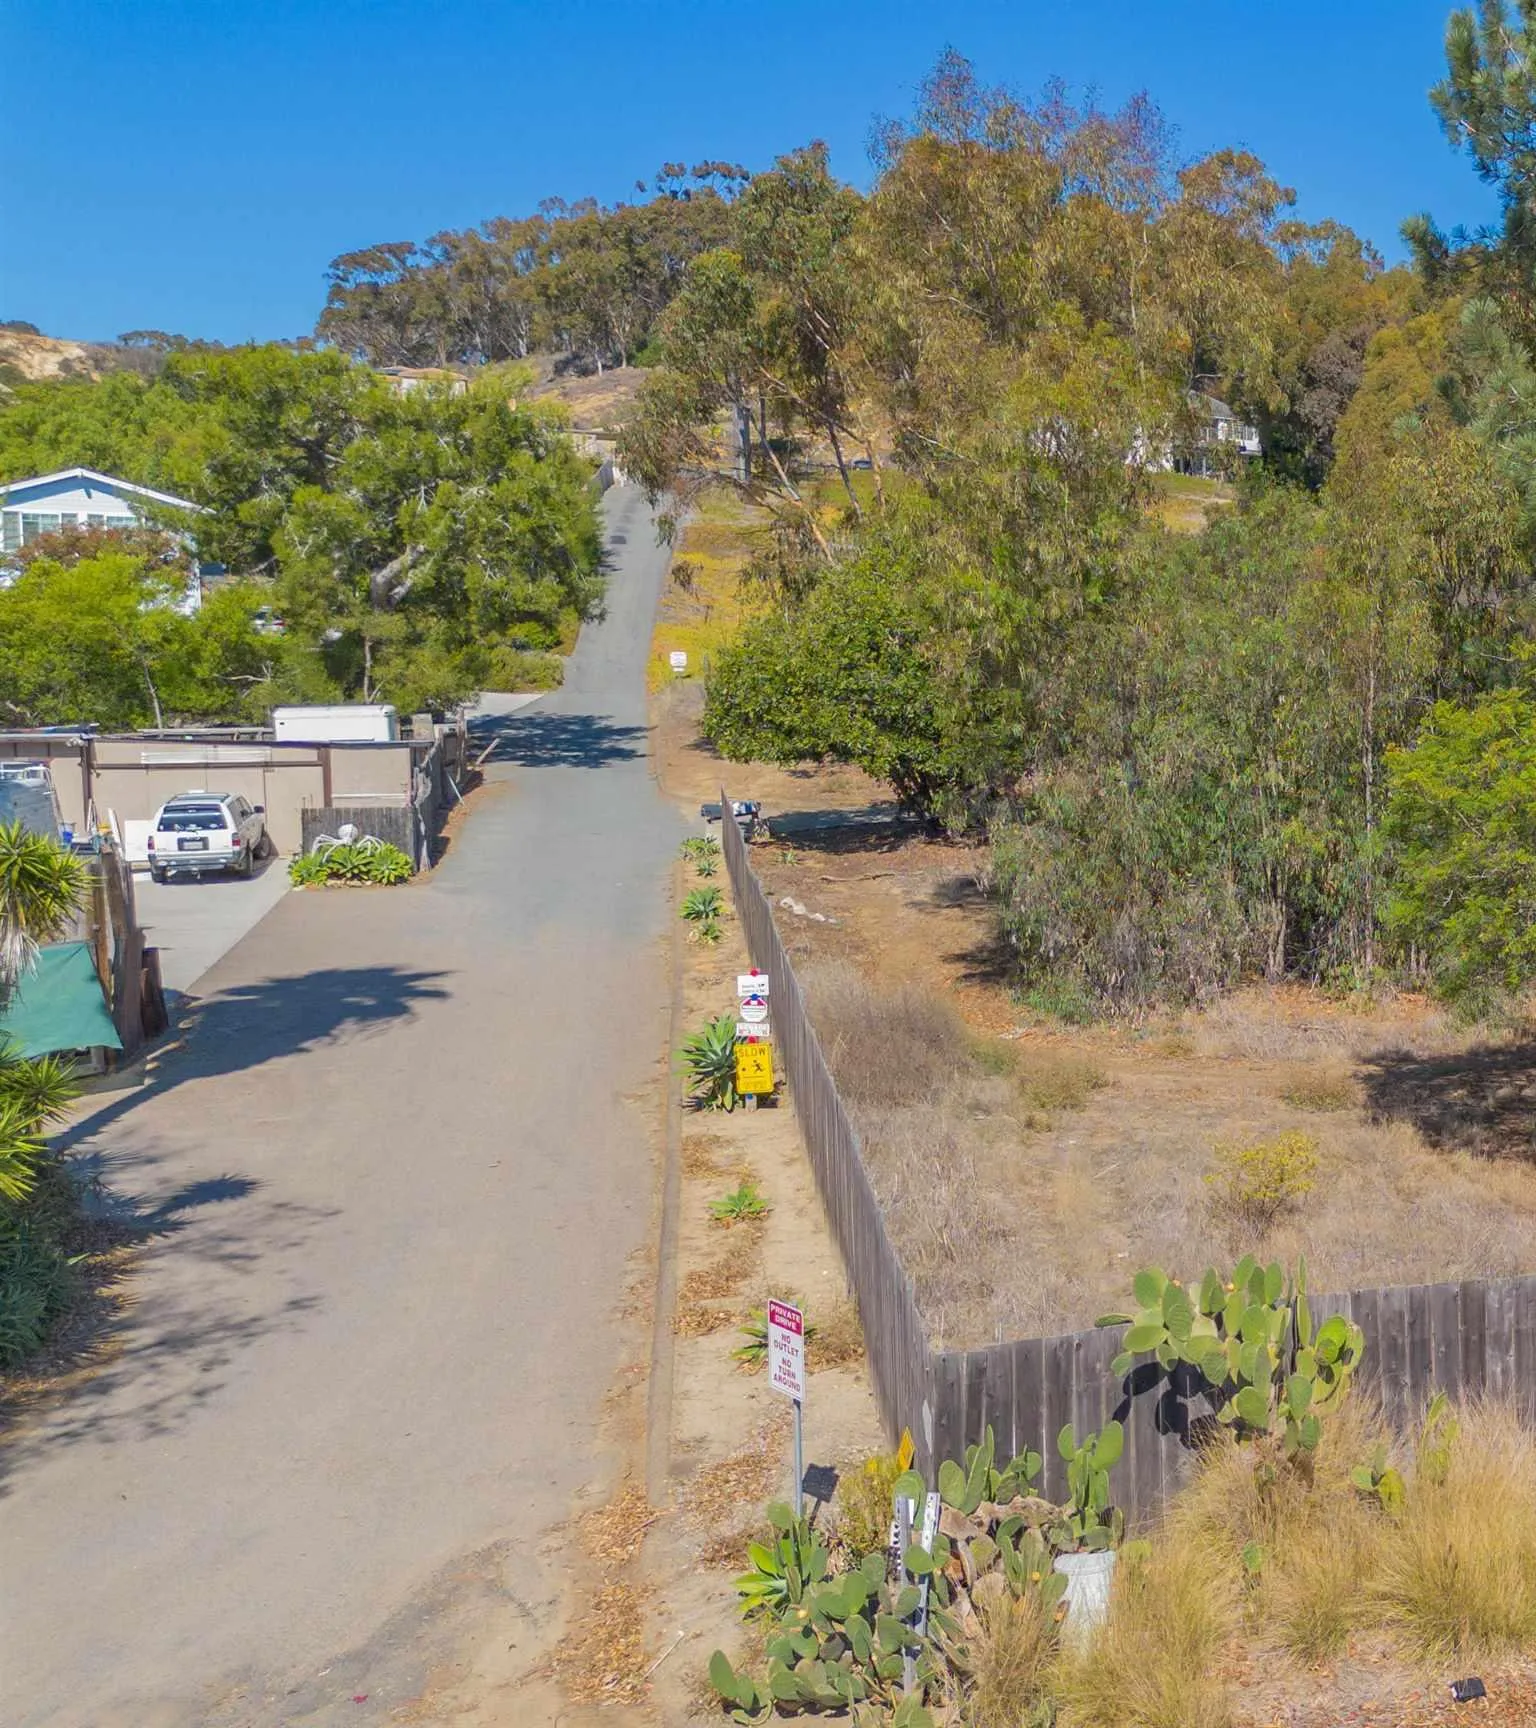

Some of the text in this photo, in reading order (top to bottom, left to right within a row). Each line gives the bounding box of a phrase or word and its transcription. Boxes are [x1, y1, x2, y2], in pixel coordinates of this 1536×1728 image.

[738, 1047, 765, 1057] SLOW
[771, 1303, 800, 1322] PRIVATE
[775, 1314, 796, 1329] DRIVE
[781, 1334, 791, 1344] NO
[774, 1340, 799, 1356] OUTLET
[782, 1357, 792, 1368] NO
[779, 1365, 796, 1379] TURN
[774, 1373, 800, 1391] AROUND
